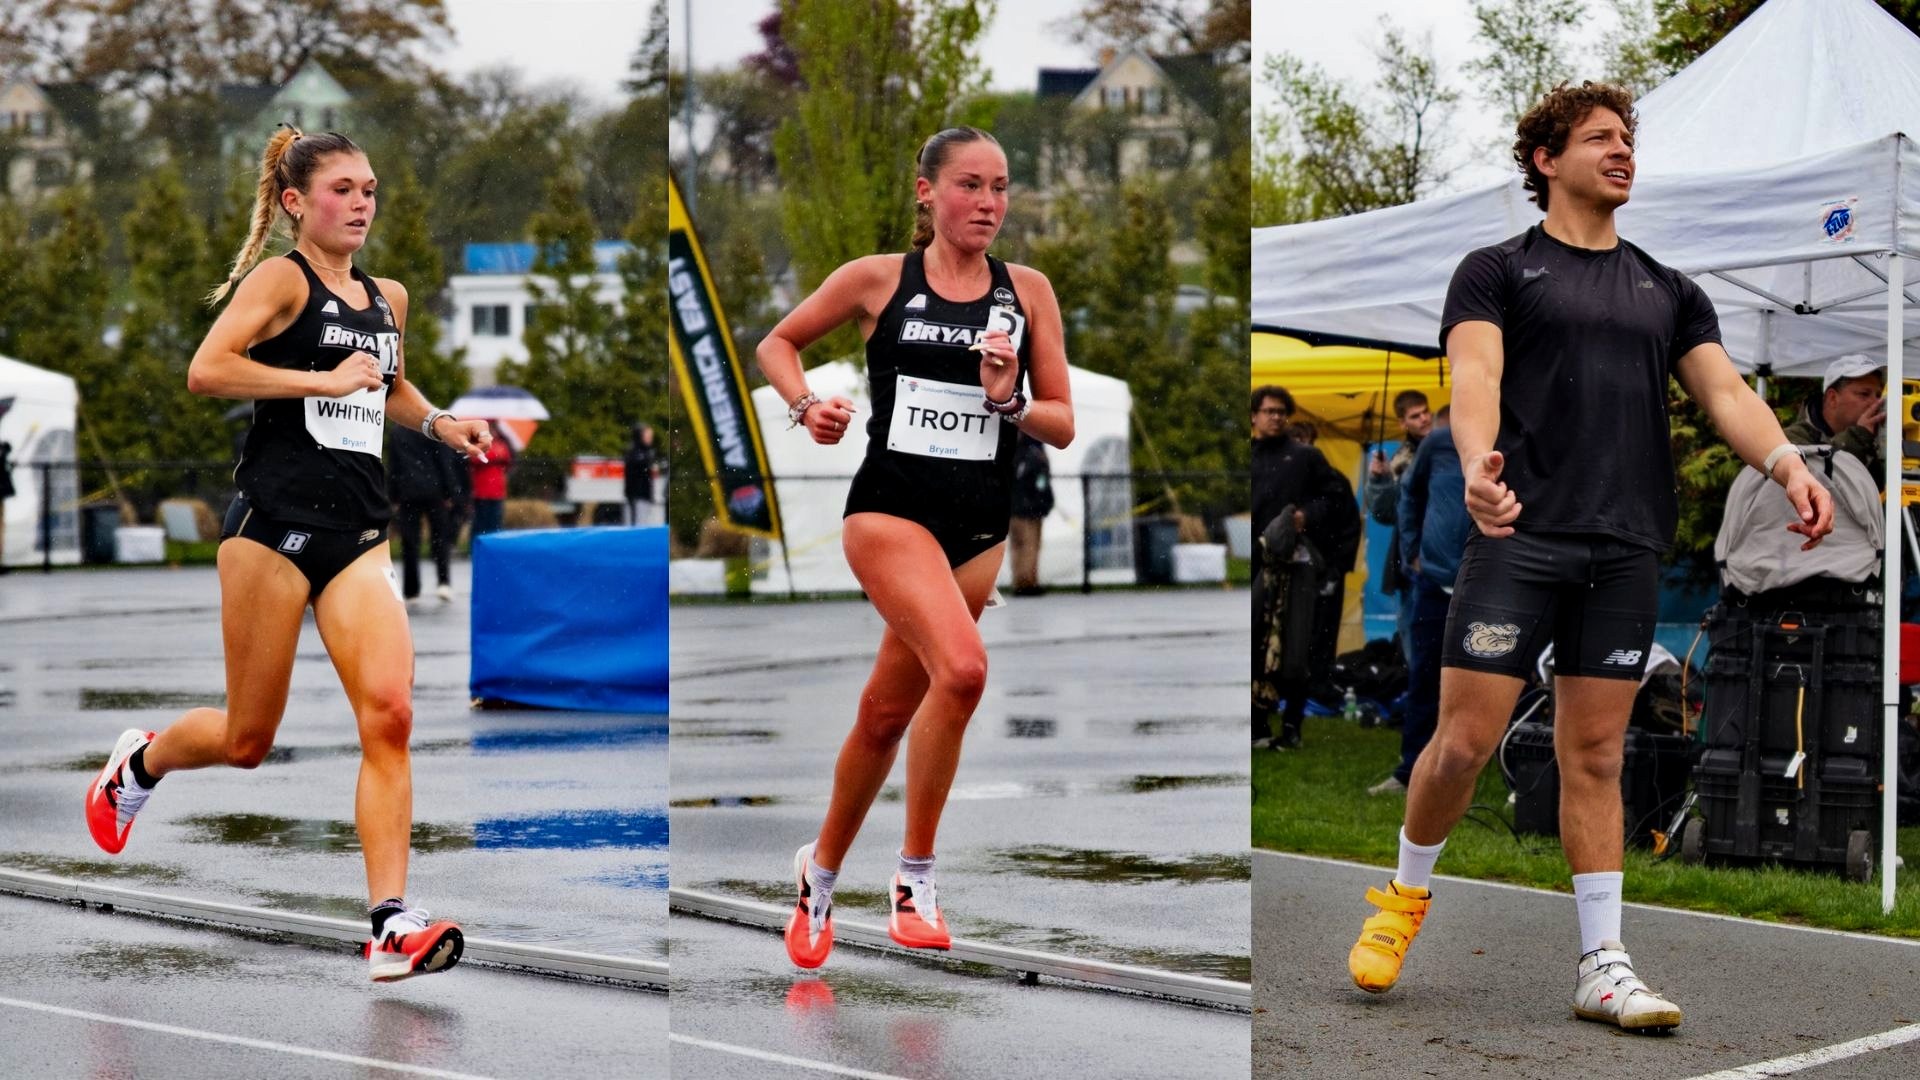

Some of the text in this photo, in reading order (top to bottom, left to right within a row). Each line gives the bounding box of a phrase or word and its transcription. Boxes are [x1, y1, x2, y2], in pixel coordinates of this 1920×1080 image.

[322, 325, 380, 351] BRYA
[901, 321, 986, 345] BRYA
[317, 400, 381, 426] WHITING
[692, 334, 748, 469] AMERICA
[907, 406, 990, 434] TROTT
[342, 437, 367, 449] Bryant
[929, 445, 958, 456] Bryant
[279, 531, 311, 553] B
